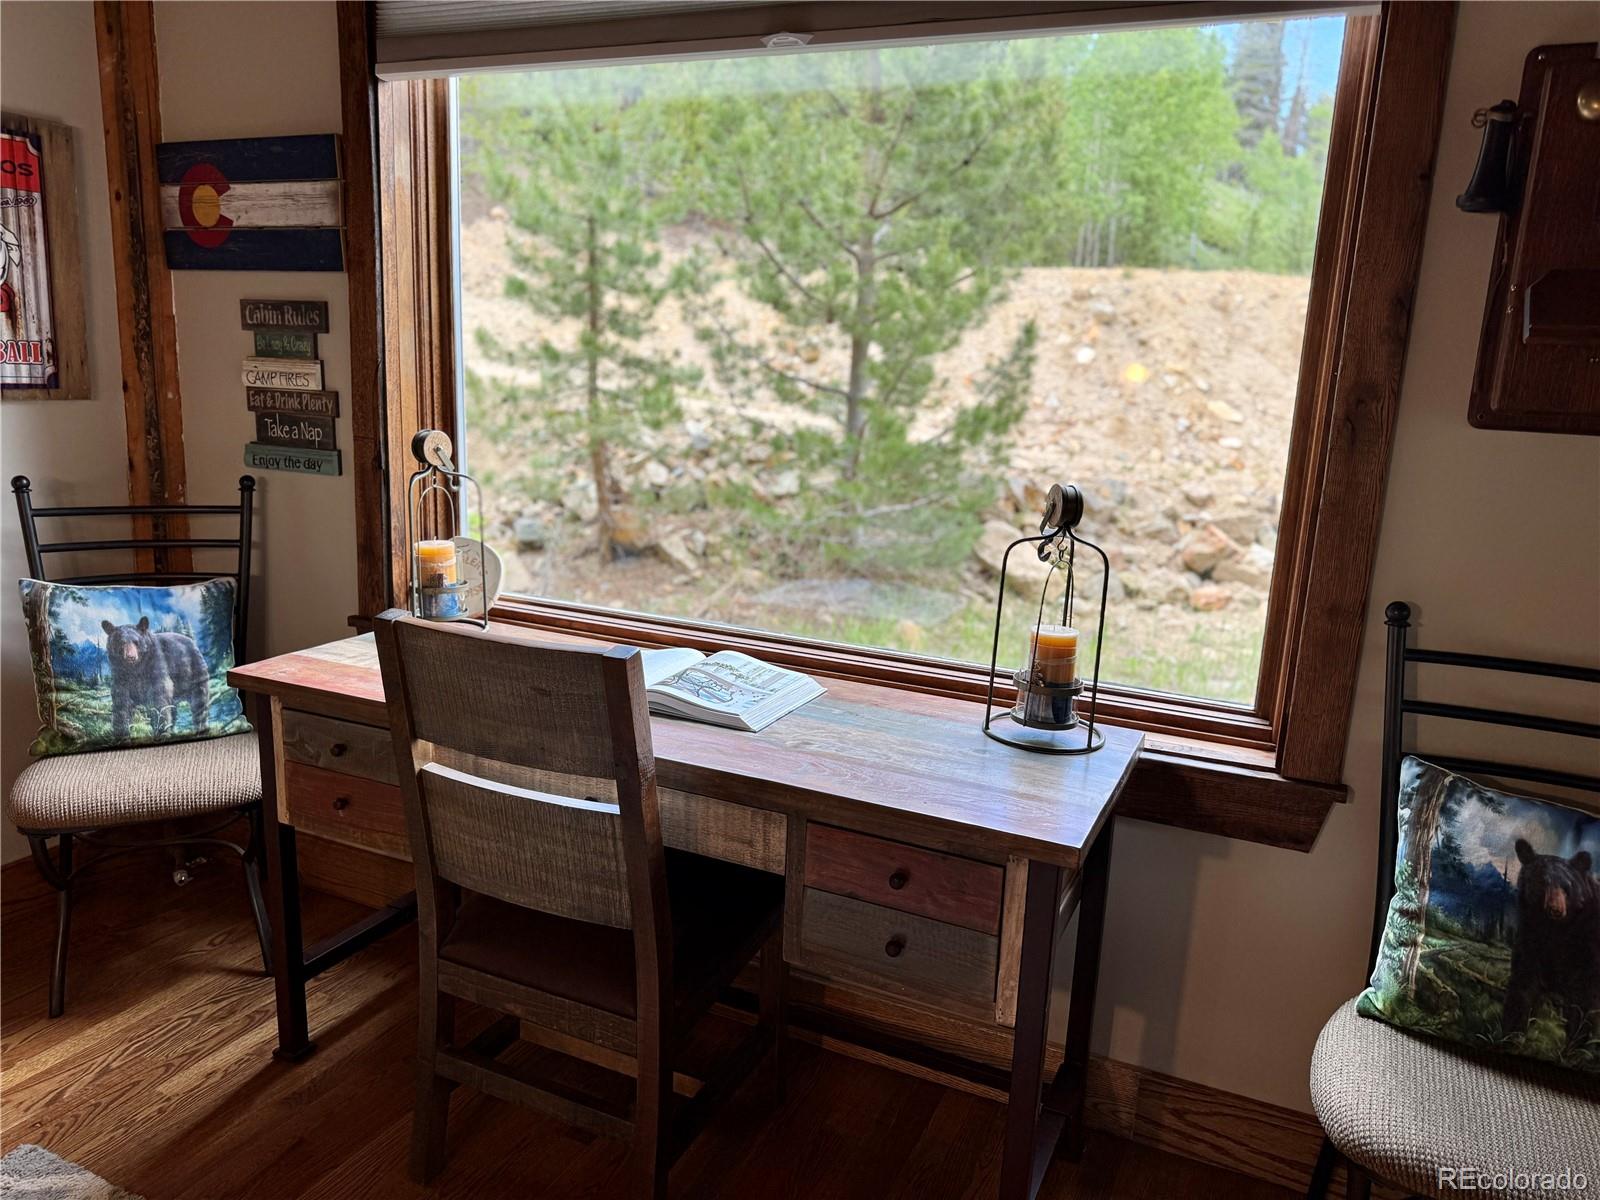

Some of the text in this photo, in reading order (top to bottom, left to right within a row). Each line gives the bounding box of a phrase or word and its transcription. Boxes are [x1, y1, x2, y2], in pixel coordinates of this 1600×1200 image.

[245, 303, 320, 326] Cabin Rules
[249, 390, 334, 415] Eat & Drink Plenty
[264, 413, 323, 448] Take a Nap
[252, 454, 323, 472] Enjoy the day
